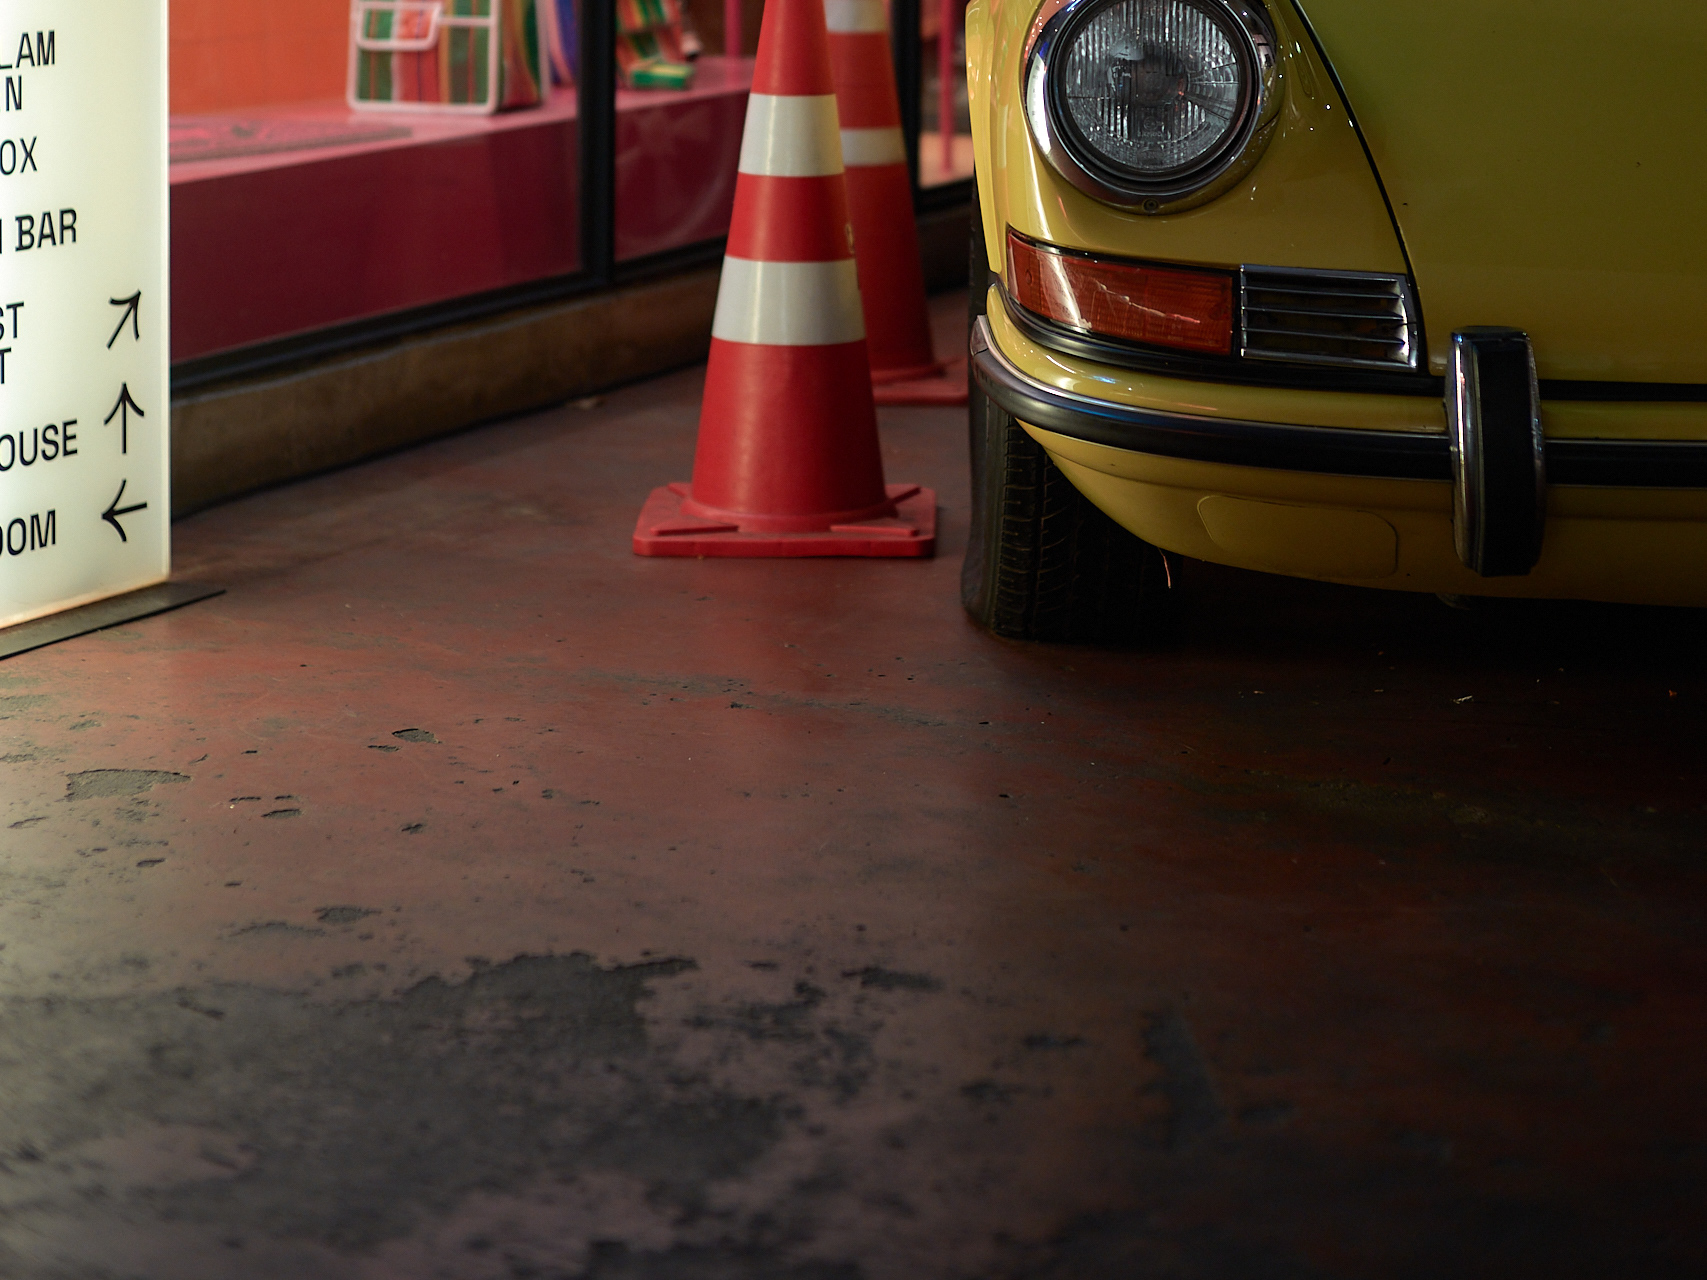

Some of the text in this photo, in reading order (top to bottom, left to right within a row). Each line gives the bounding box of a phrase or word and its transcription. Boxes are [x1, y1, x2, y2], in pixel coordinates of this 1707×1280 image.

[0, 136, 38, 176] OX
[15, 207, 77, 252] BAR
[0, 418, 78, 471] OUSE
[0, 508, 56, 556] OM
